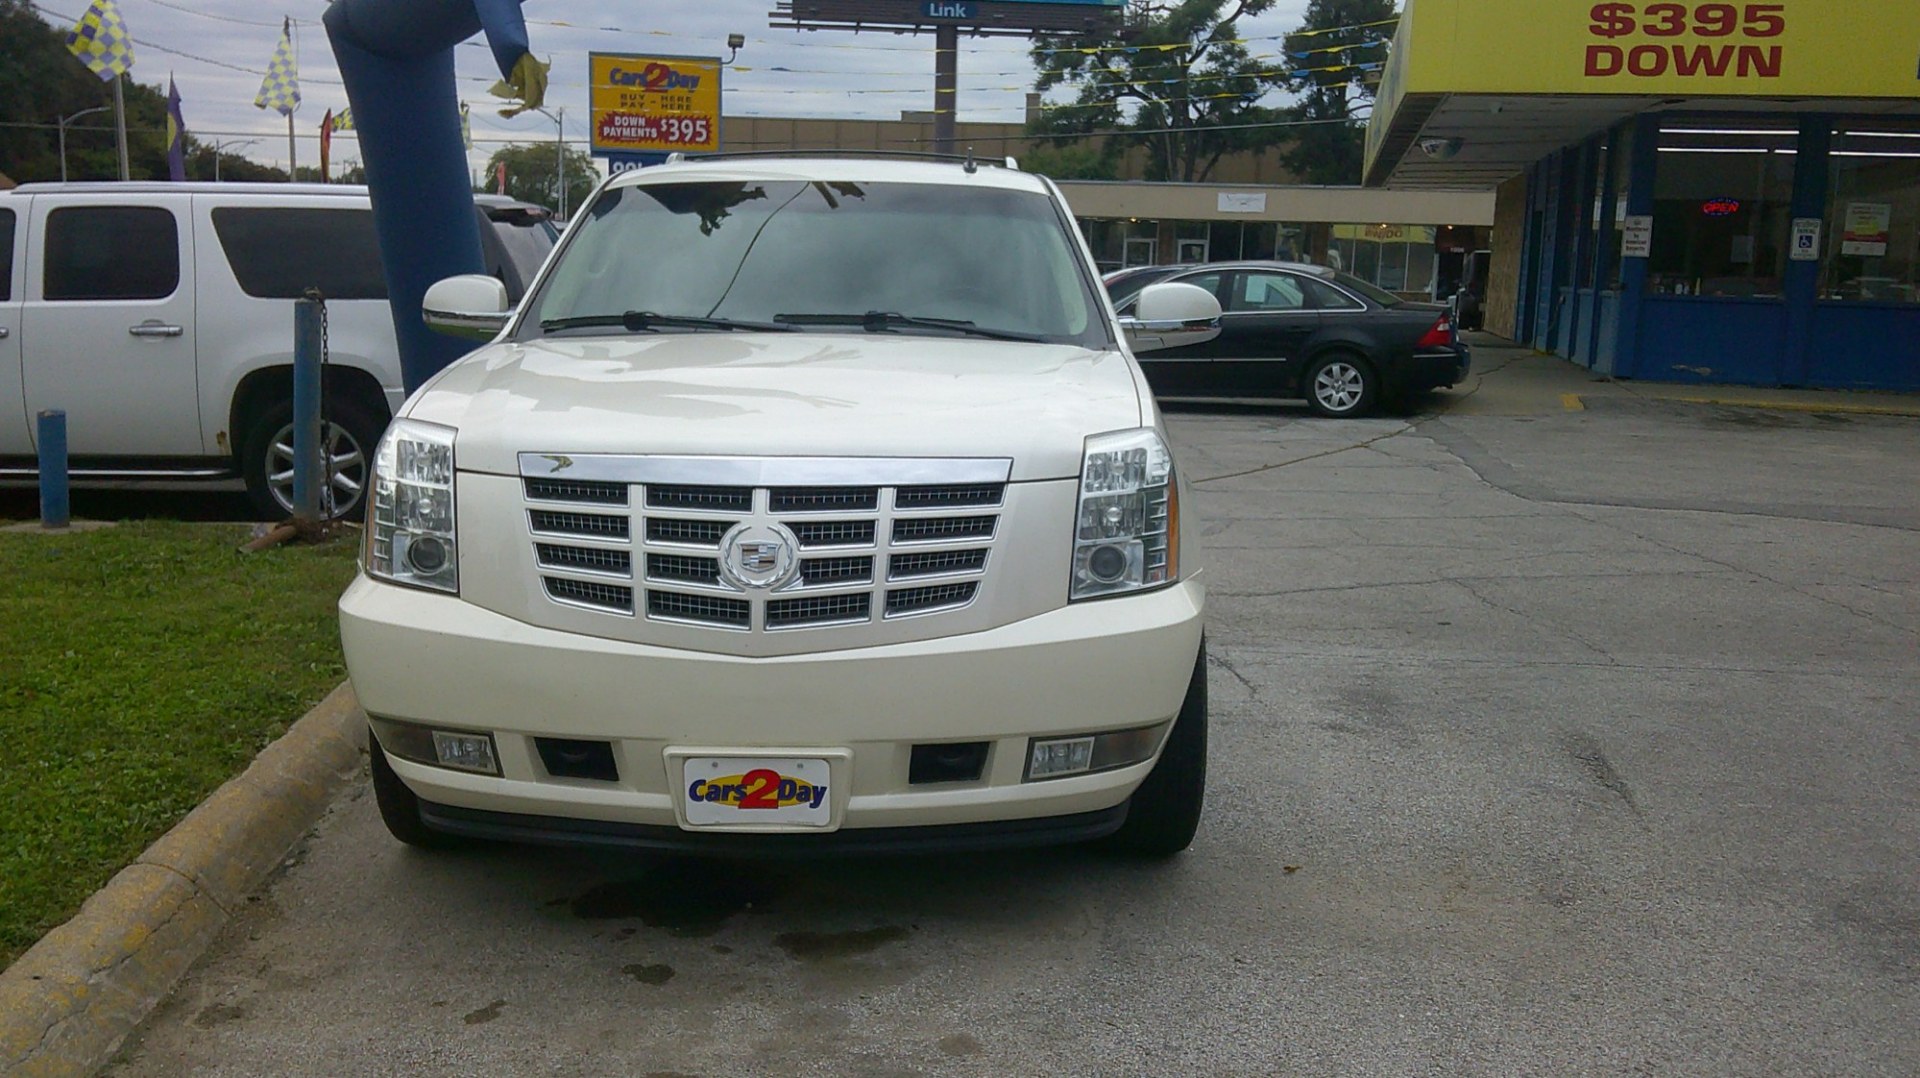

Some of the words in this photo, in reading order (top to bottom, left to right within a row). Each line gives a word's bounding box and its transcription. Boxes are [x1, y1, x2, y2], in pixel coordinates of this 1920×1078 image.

[930, 2, 966, 17] Link
[1589, 2, 1785, 38] $395
[1584, 44, 1783, 77] DOWN
[620, 93, 645, 101] BUY
[661, 95, 692, 103] HERE
[661, 103, 692, 111] HERE
[603, 126, 658, 138] PAYMENTS
[614, 116, 646, 127] DOWN
[660, 118, 708, 142] $395
[1703, 201, 1740, 214] OPEN
